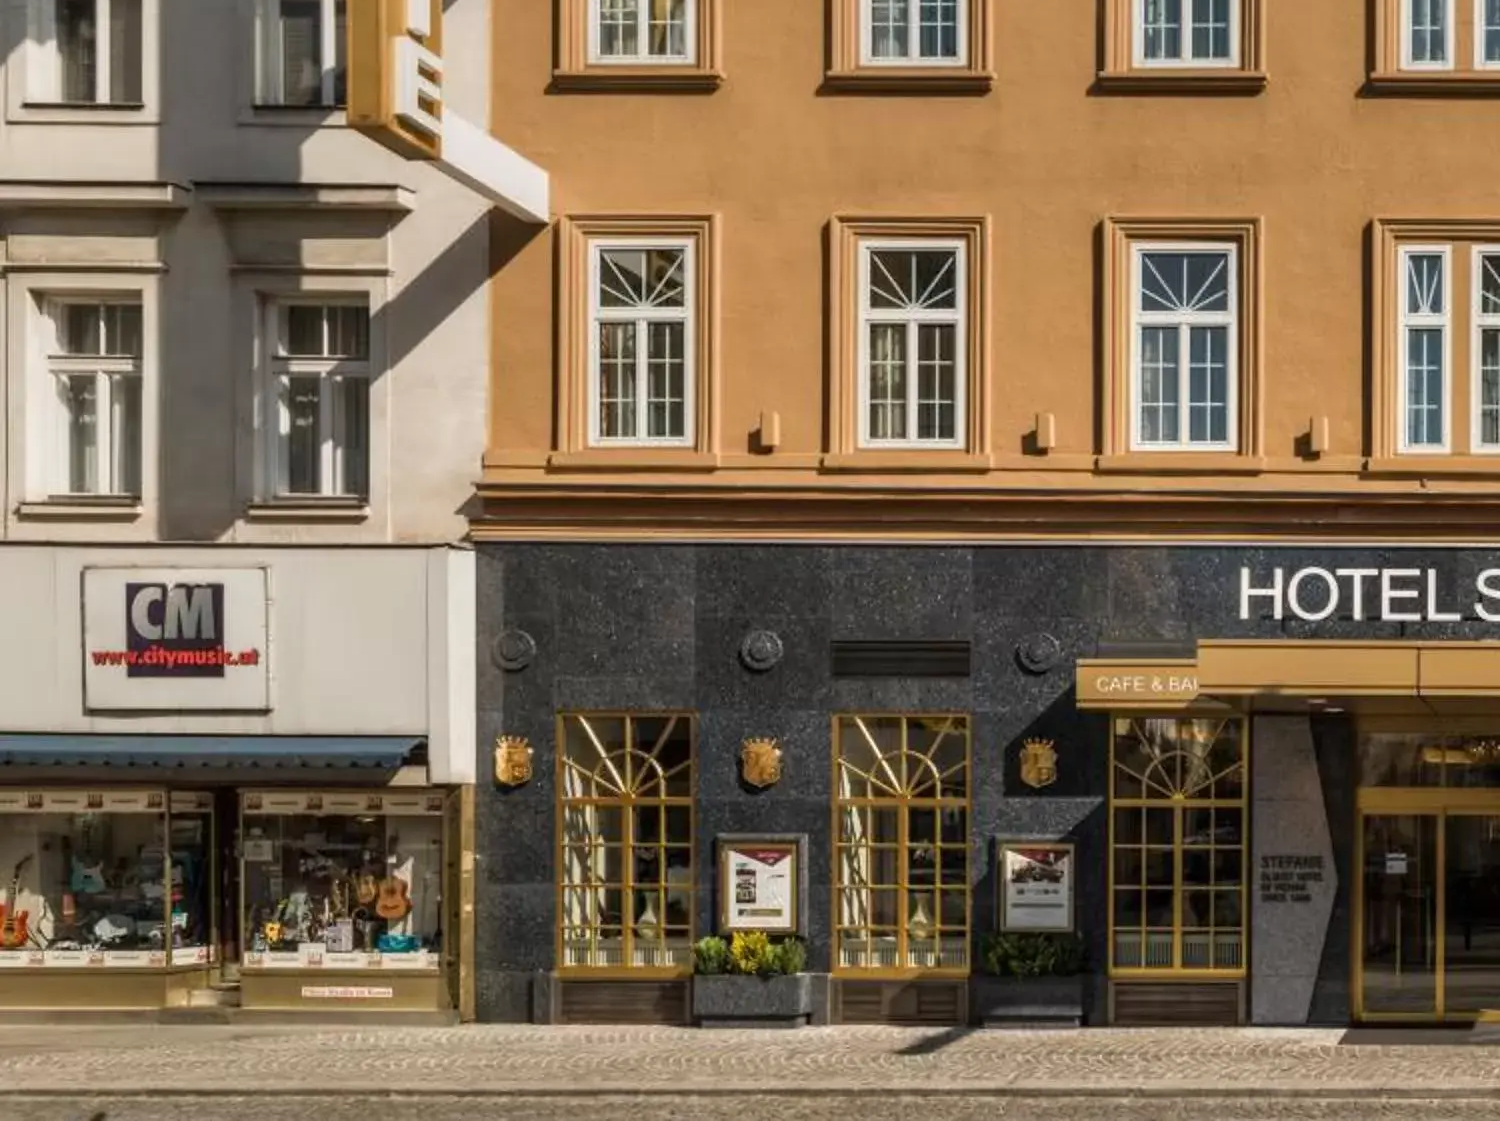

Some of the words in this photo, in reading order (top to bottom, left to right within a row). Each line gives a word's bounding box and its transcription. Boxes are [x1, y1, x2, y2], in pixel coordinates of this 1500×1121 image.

[131, 585, 216, 641] CM
[1239, 567, 1461, 622] HOTEL
[92, 645, 260, 669] www.citymusic.at
[1096, 676, 1146, 693] CAFE
[1151, 676, 1163, 693] &
